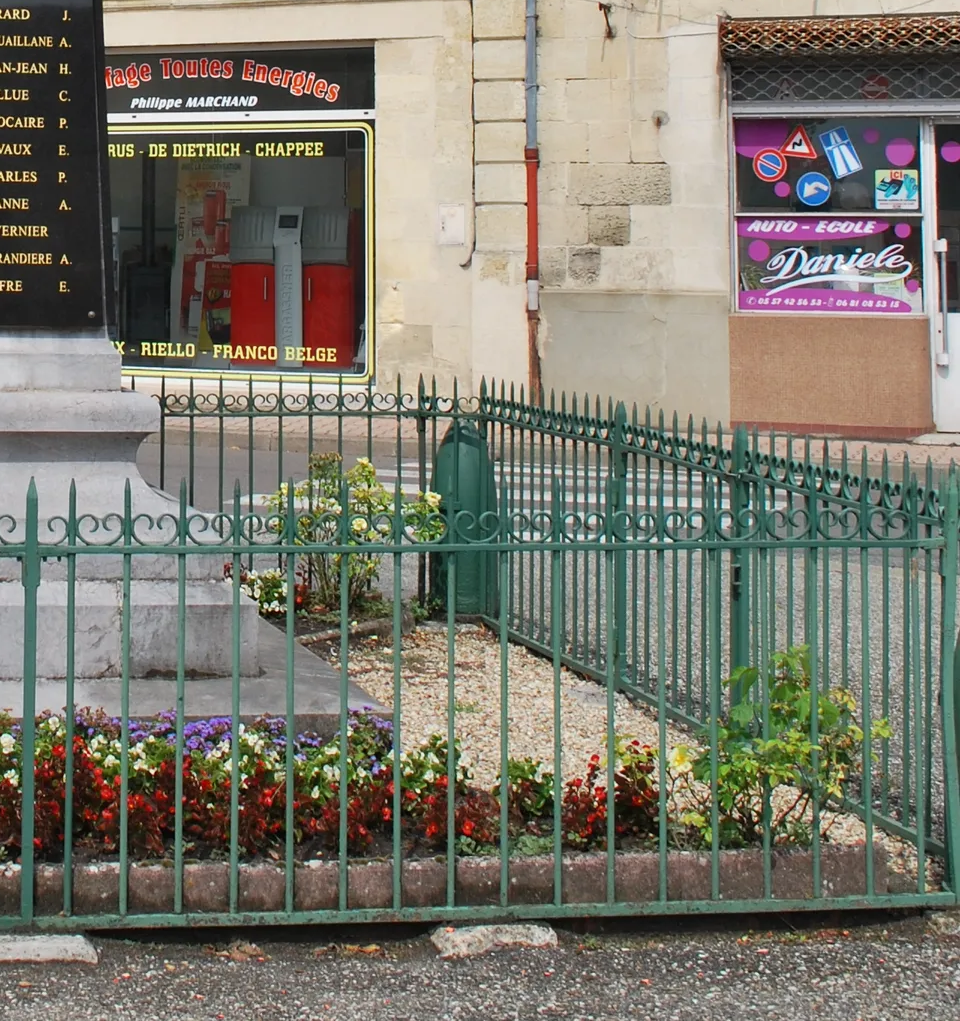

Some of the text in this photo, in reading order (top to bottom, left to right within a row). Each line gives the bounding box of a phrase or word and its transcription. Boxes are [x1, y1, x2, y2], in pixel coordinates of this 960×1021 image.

[62, 10, 71, 22] J.
[59, 37, 72, 49] A.
[59, 64, 72, 76] H.
[160, 58, 234, 79] Toutes
[242, 59, 340, 103] Energies
[59, 91, 70, 103] C.
[130, 96, 258, 110] Philippe MARCHAND
[59, 117, 69, 130] P.
[58, 145, 69, 157] E.
[149, 143, 168, 158] DE
[173, 142, 241, 157] DIETRICH
[256, 142, 324, 156] CHAPPEE
[58, 172, 67, 184] P.
[59, 200, 72, 212] A.
[747, 220, 798, 233] AUTO
[815, 220, 877, 234] ECOLE
[60, 255, 72, 266] A.
[760, 244, 913, 283] Daniele
[59, 281, 70, 294] E.
[758, 297, 769, 305] 05
[797, 298, 808, 306] 56
[836, 299, 847, 307] 06
[141, 342, 195, 358] RIELLO
[213, 345, 278, 361] FRANCO
[285, 346, 337, 362] BELGE
